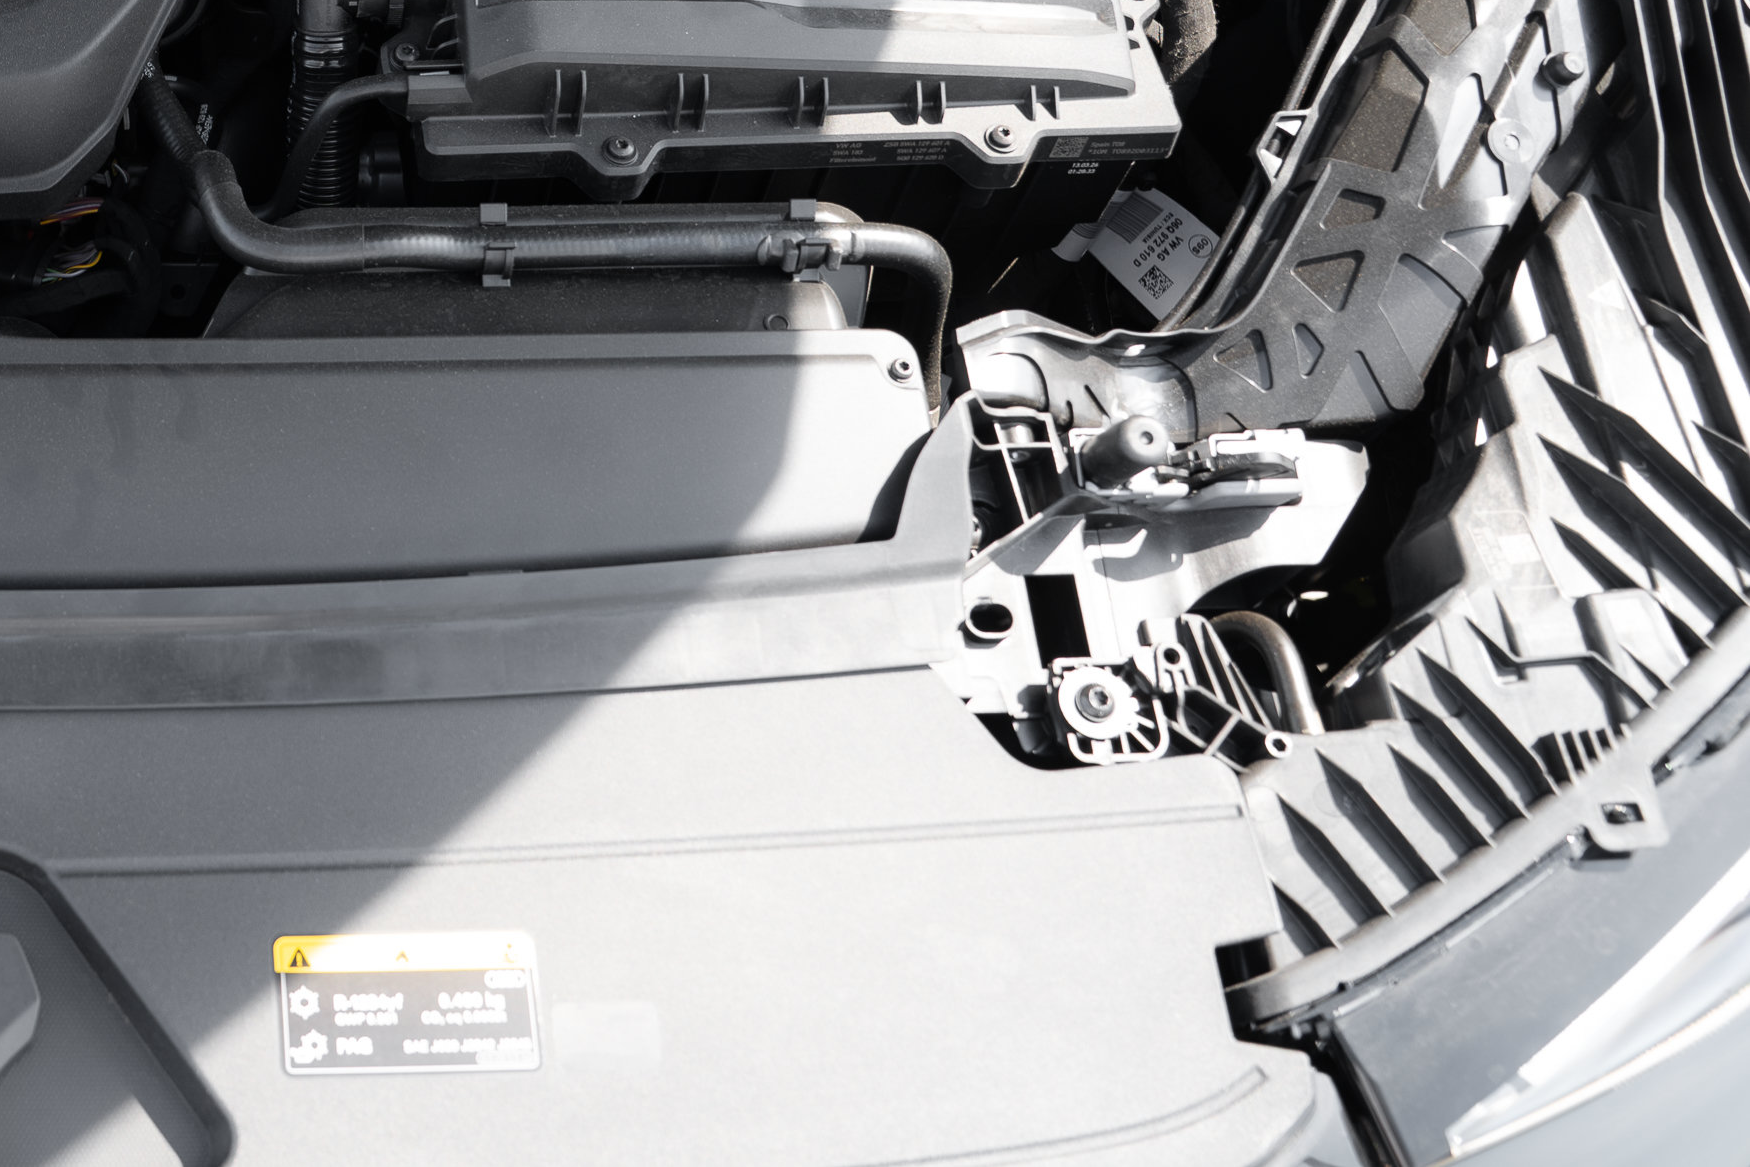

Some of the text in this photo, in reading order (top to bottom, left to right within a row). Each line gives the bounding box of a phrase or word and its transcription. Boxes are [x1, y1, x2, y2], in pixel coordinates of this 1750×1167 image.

[1131, 216, 1183, 268] 06Q 972 610 D
[1155, 234, 1184, 262] VW AG
